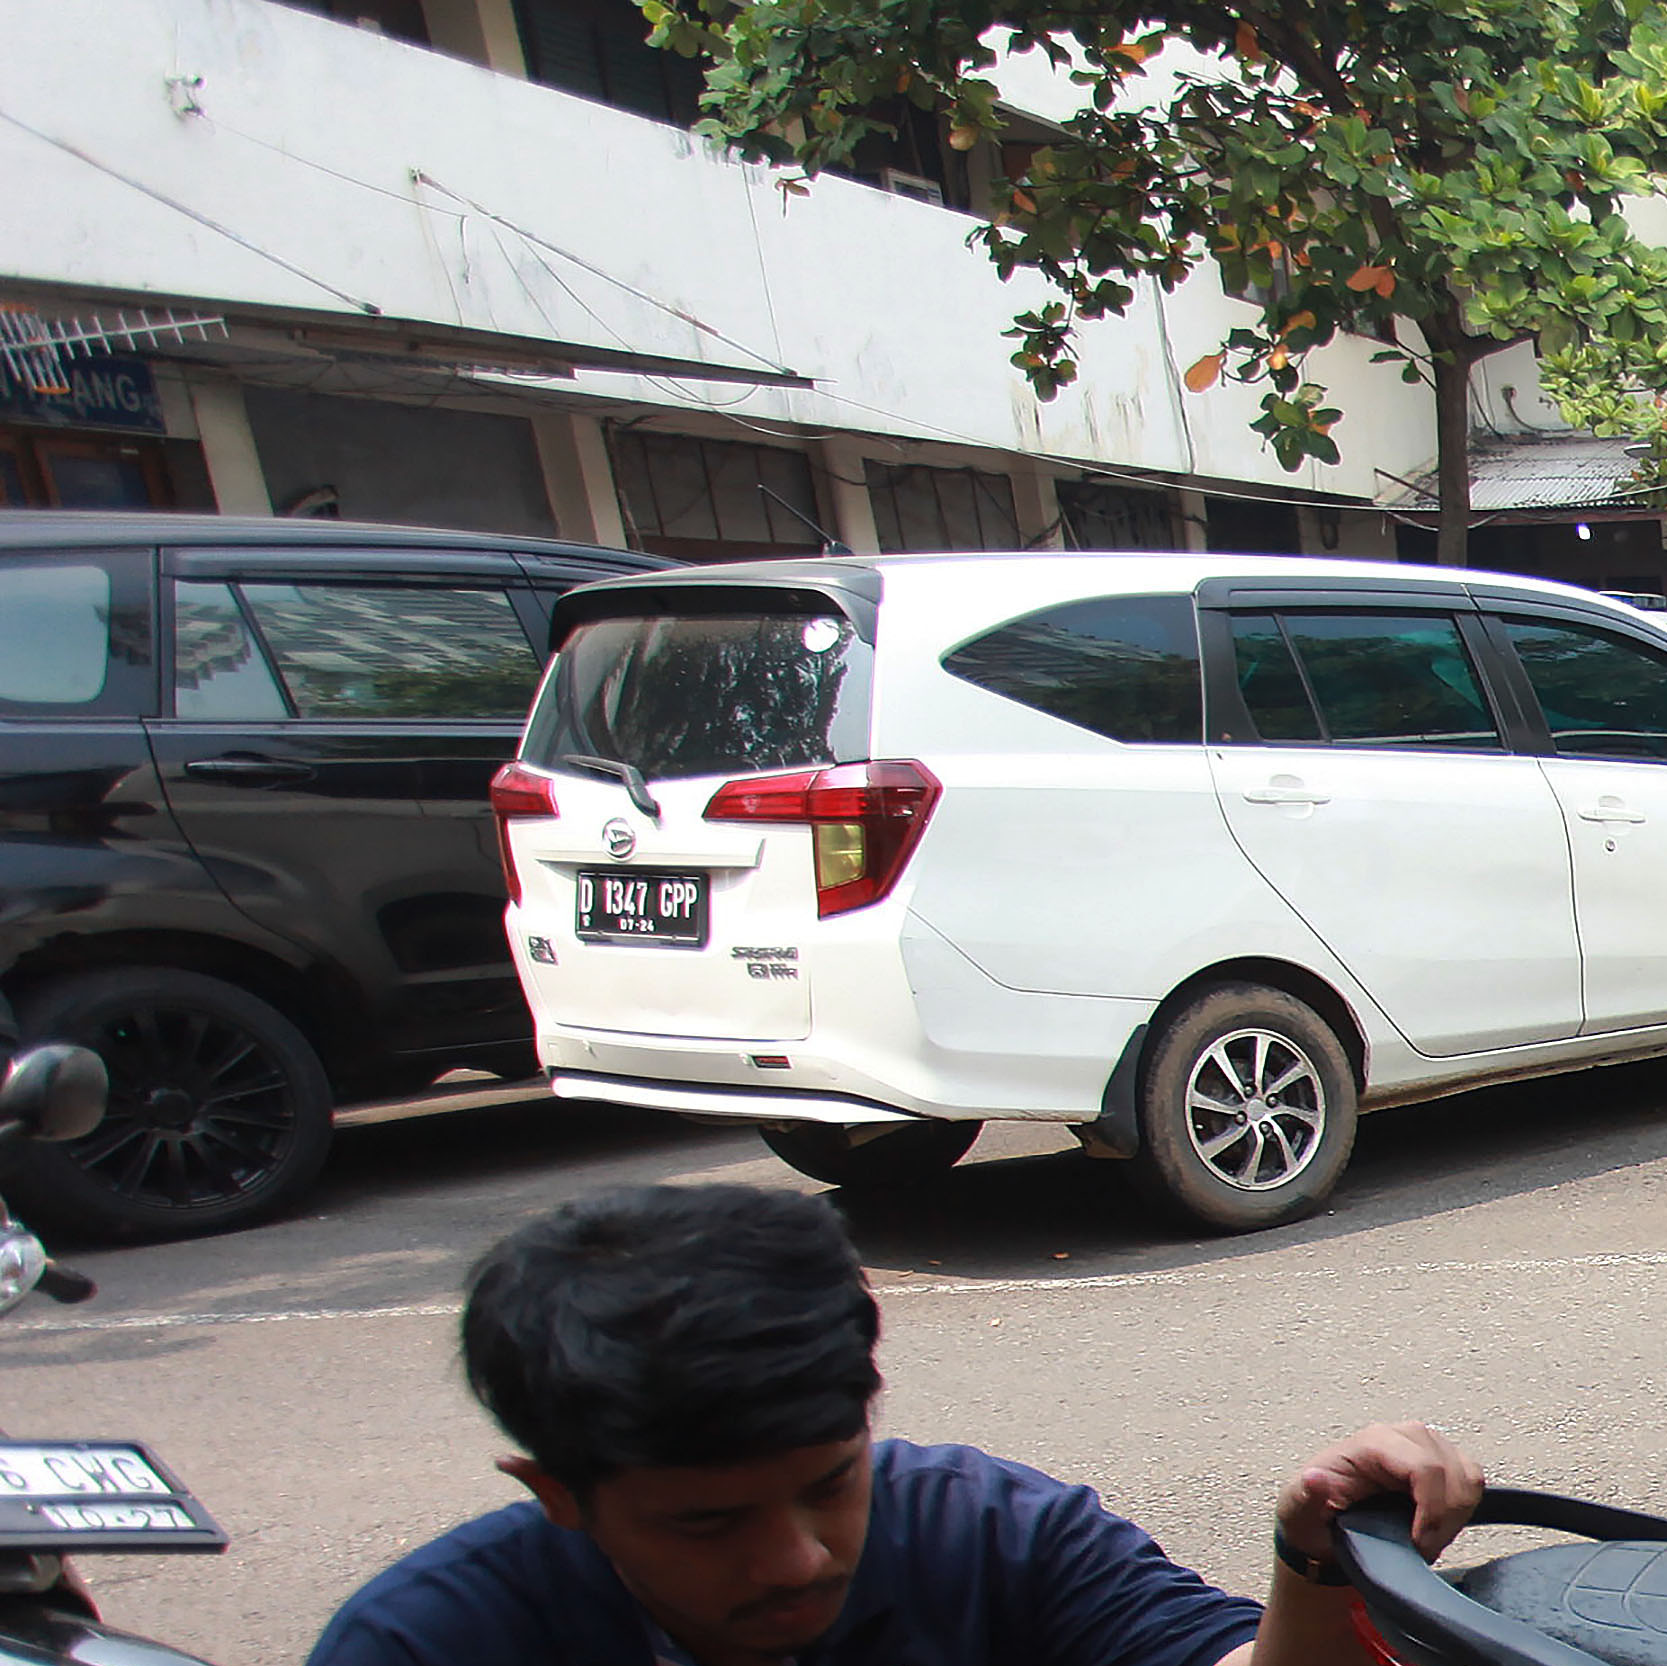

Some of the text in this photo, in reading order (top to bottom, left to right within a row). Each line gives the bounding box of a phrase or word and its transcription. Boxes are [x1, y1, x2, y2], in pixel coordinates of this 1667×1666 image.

[580, 880, 698, 919] D 1347 GPP
